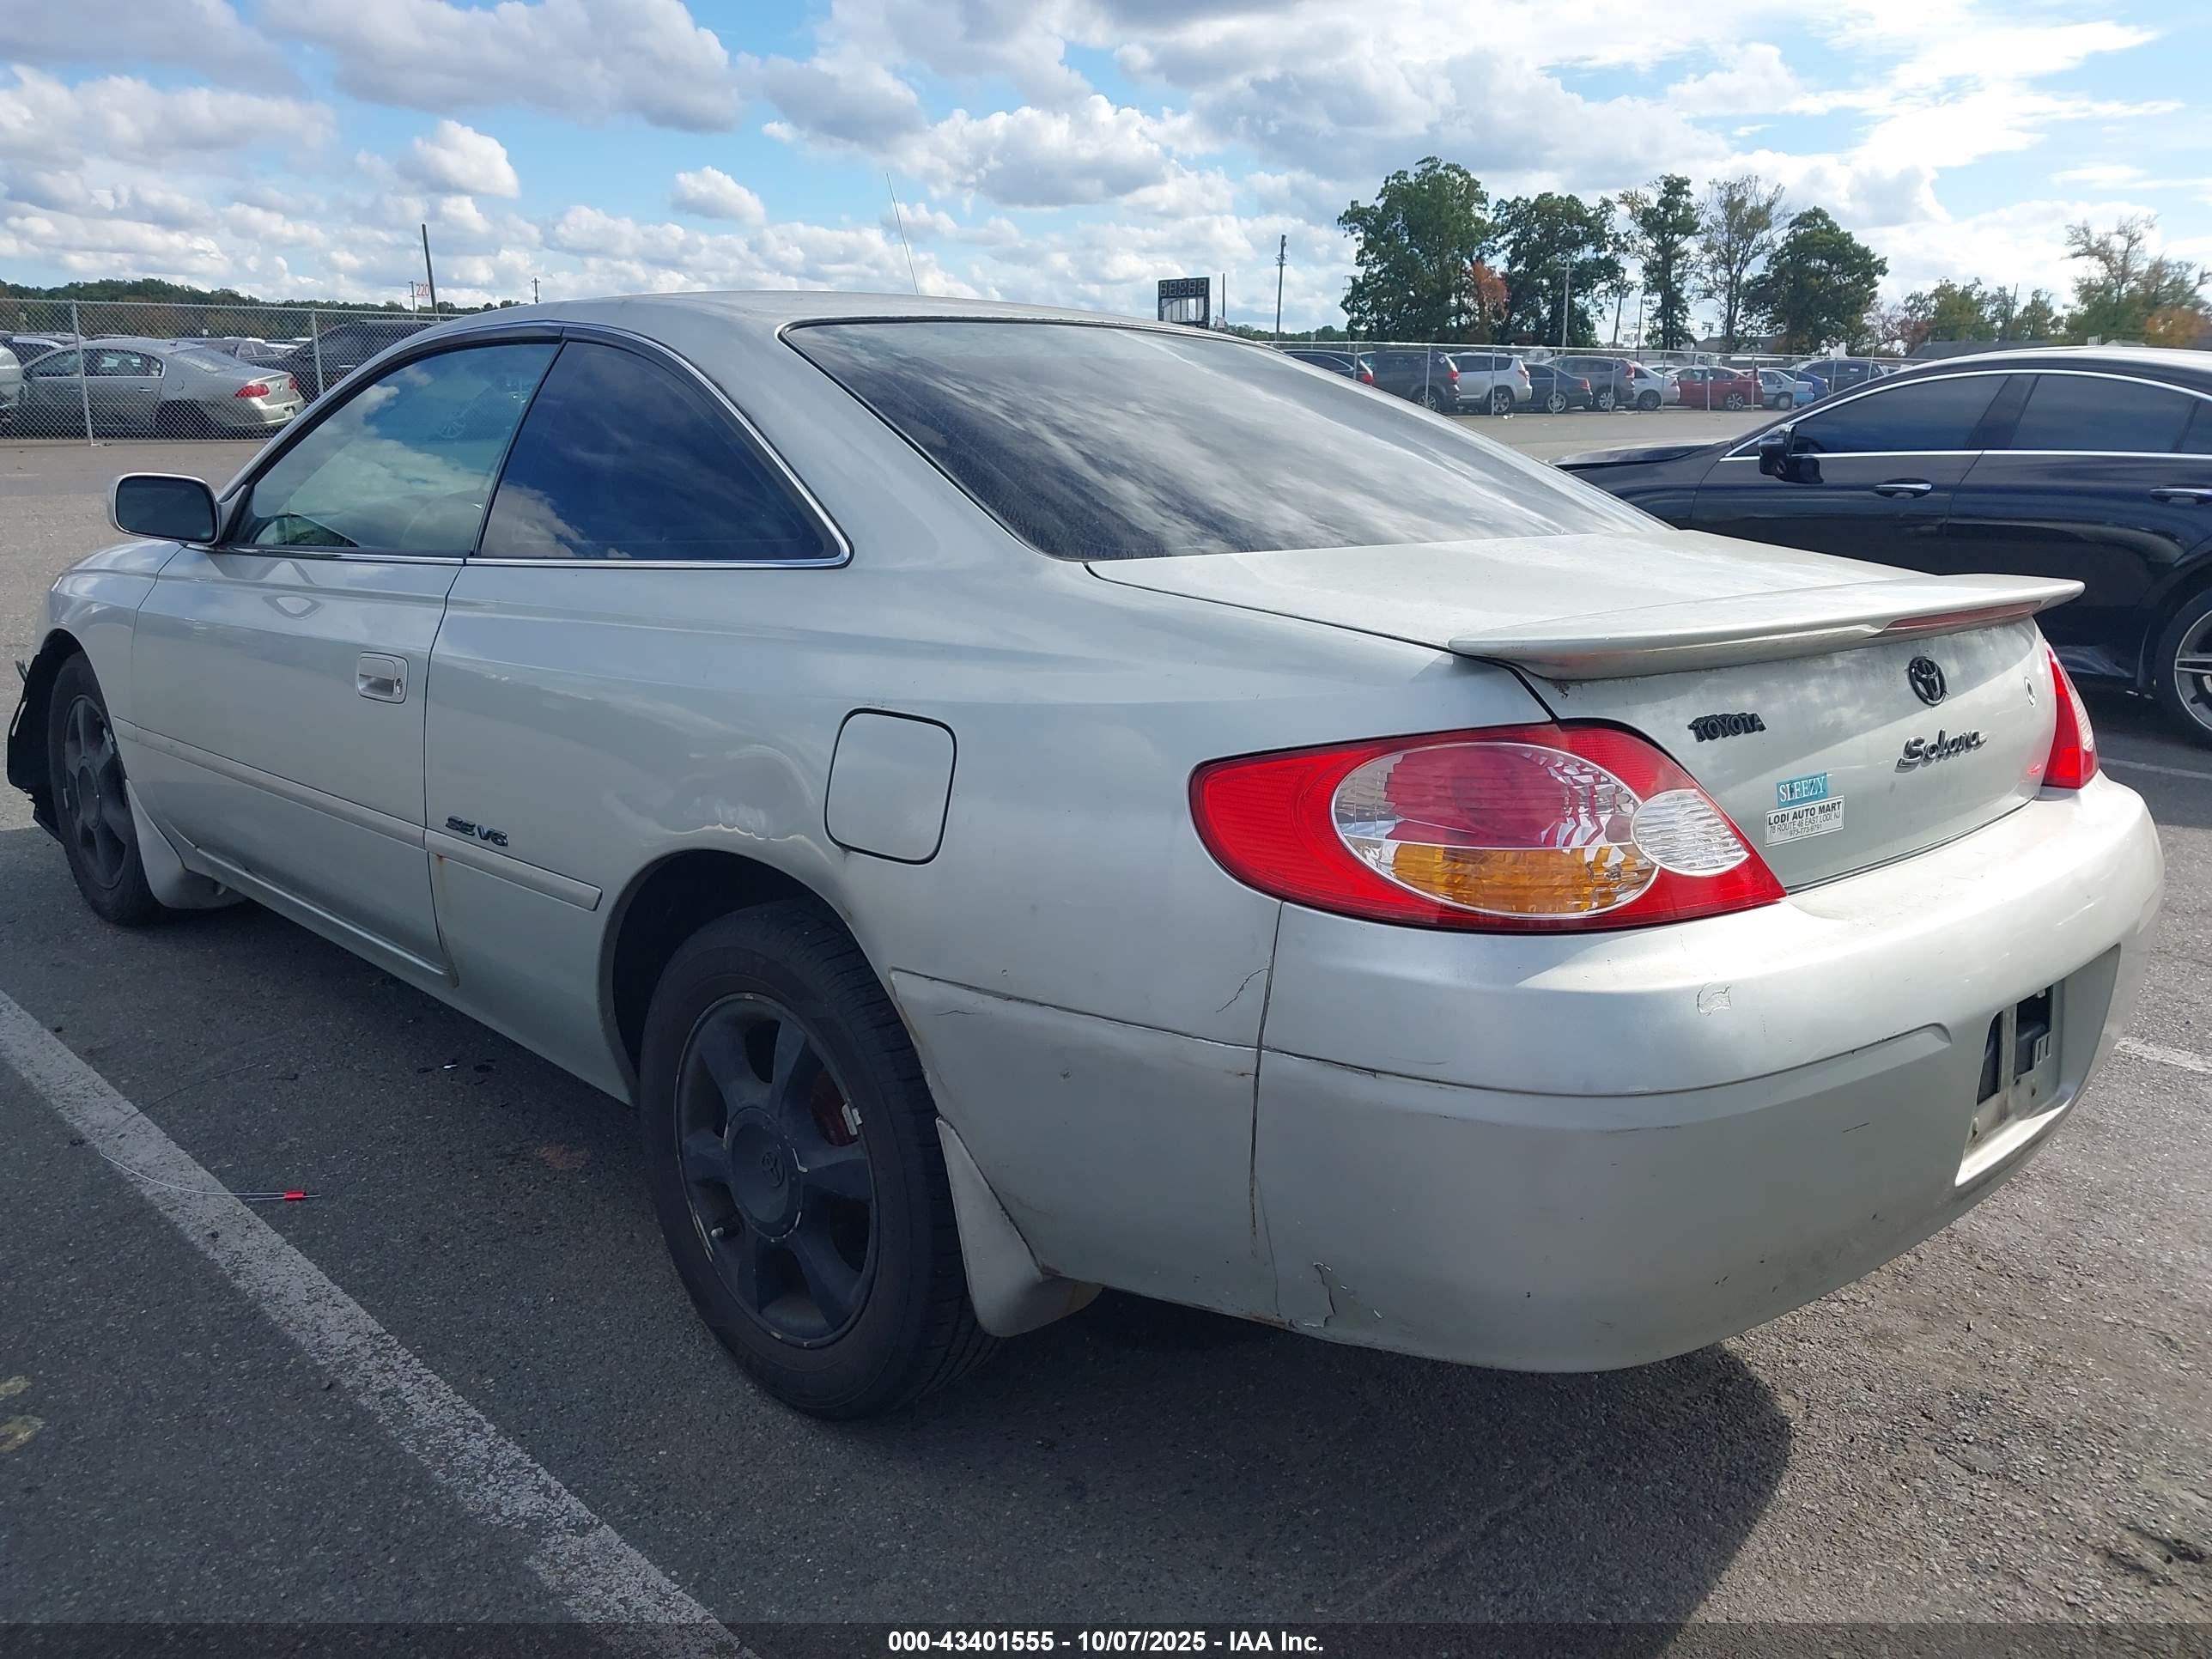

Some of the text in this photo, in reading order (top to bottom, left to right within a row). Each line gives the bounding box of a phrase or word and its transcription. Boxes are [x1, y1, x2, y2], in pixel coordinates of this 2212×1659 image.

[416, 283, 429, 296] 220
[1687, 713, 1766, 742] TOYOTA
[1895, 729, 1986, 772] Solara
[1778, 775, 1826, 803] SLEEZY
[1768, 801, 1842, 826] LODI AUTO MART
[1769, 826, 1776, 835] 78
[1777, 822, 1796, 833] ROUTE
[1797, 819, 1804, 828] 46
[1804, 817, 1819, 826] EAST
[1833, 811, 1841, 819] NJ
[446, 816, 508, 847] SE V6
